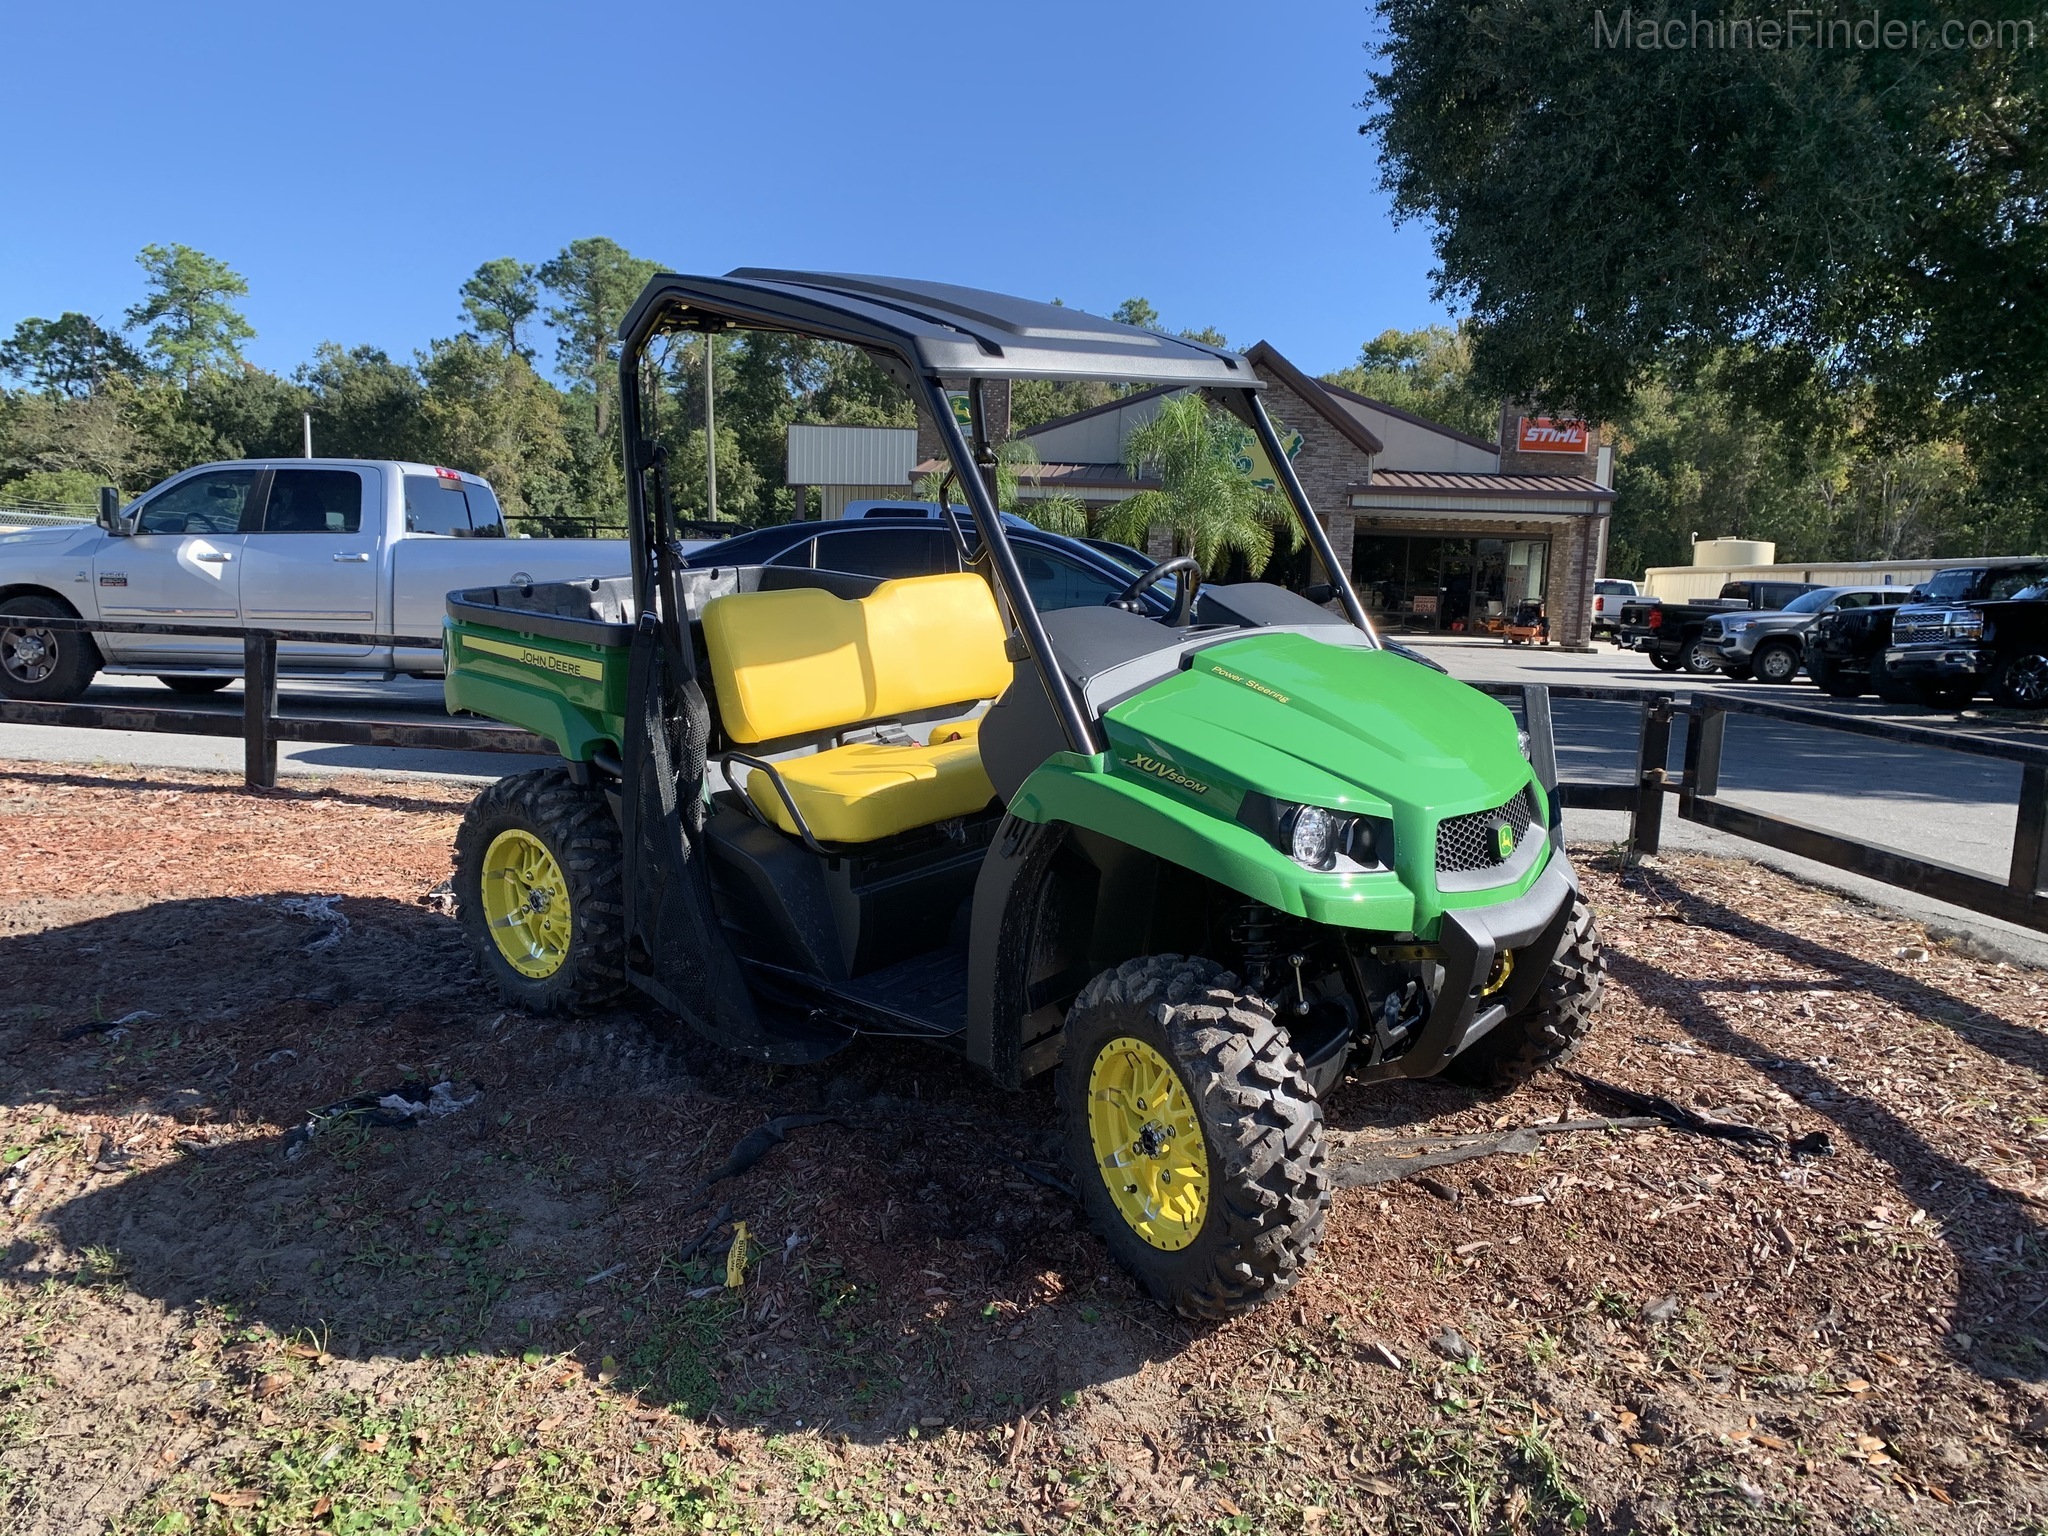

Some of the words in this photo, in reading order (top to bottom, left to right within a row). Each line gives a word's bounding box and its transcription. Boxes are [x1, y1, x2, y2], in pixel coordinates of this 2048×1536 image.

[1524, 428, 1582, 443] STIHL
[519, 649, 547, 666] JOHN
[548, 656, 581, 676] DEERE
[1211, 665, 1244, 682] Power
[1245, 679, 1289, 704] Steering
[1129, 752, 1208, 793] XUV590M
